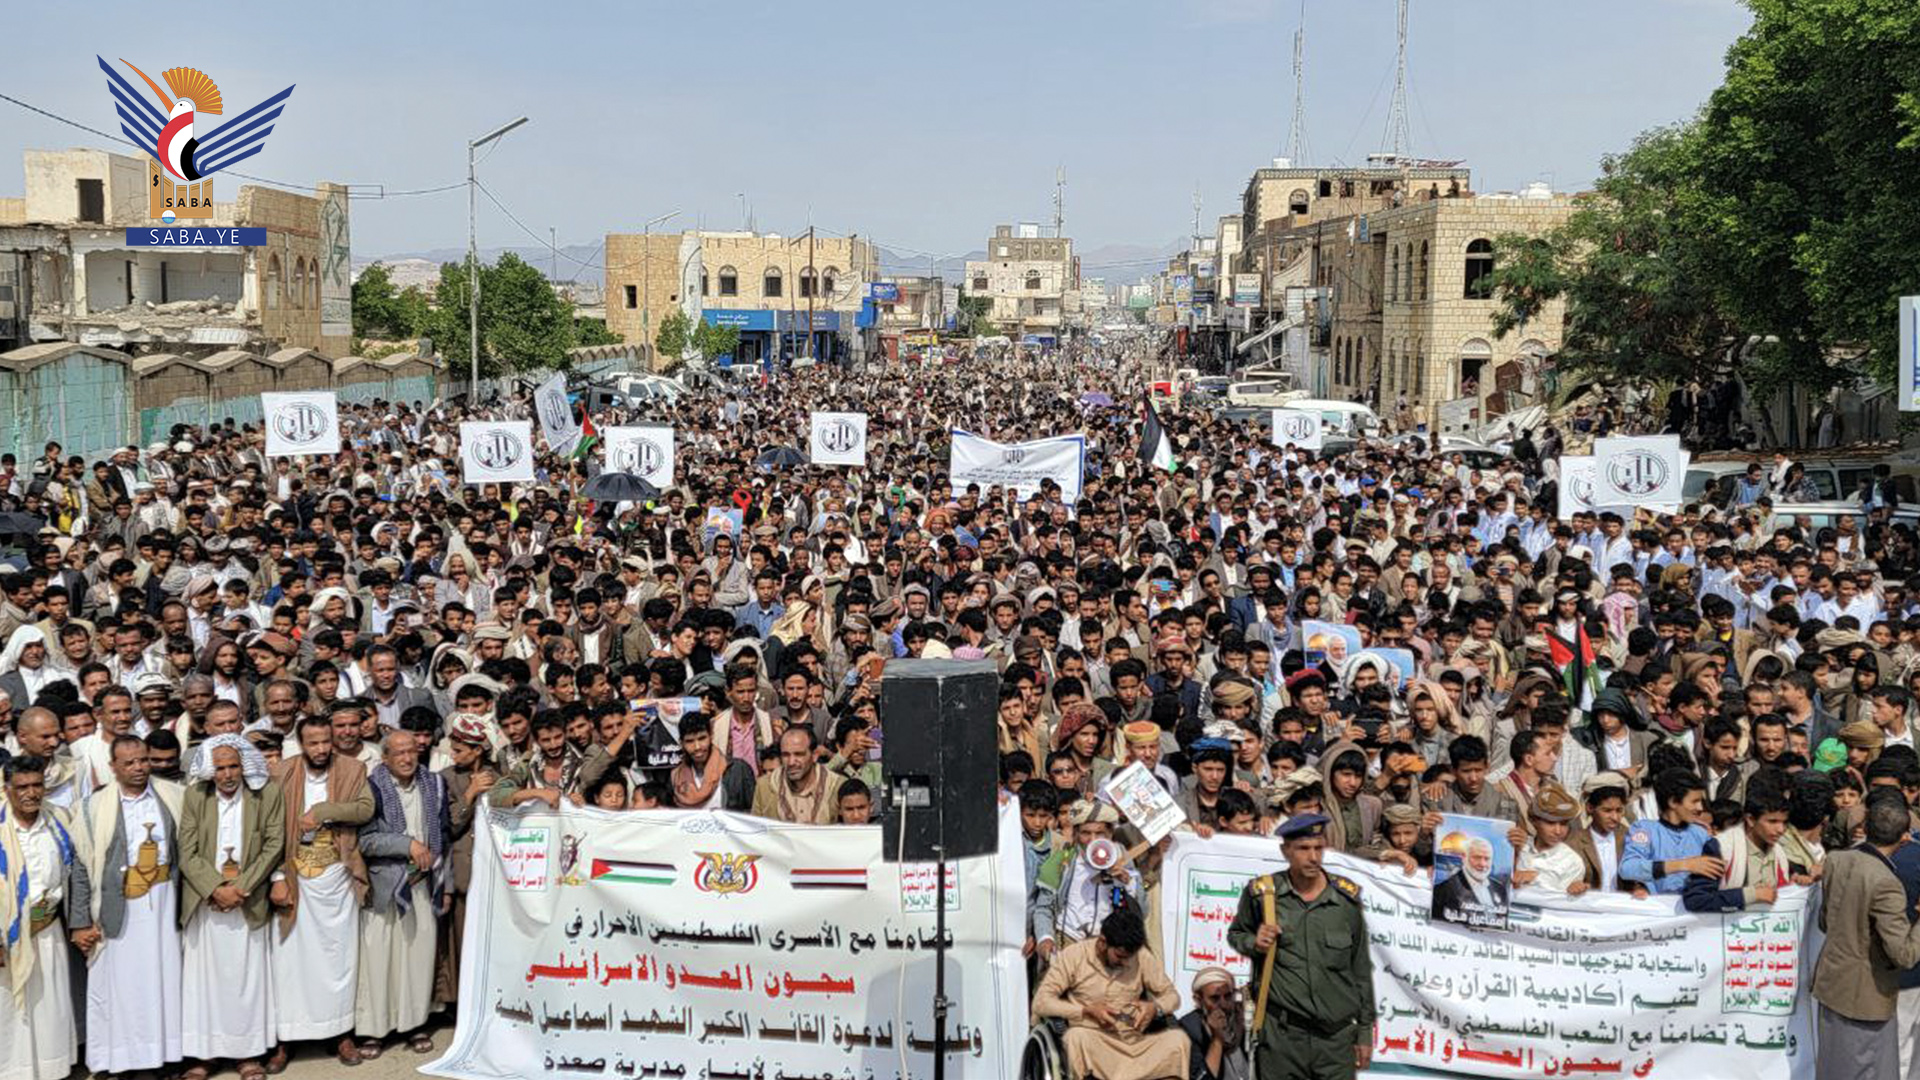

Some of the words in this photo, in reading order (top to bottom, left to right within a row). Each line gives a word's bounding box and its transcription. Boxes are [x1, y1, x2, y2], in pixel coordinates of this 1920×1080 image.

[565, 908, 583, 944] في
[589, 909, 643, 938] الأحرار
[649, 920, 761, 949] الفلسطينيين
[1644, 926, 1687, 946] تلبية
[1726, 913, 1770, 939] أكبر
[1772, 916, 1797, 933] الله
[849, 933, 876, 954] مع
[1400, 934, 1428, 952] الملك
[1431, 942, 1458, 959] عبد
[1474, 942, 1515, 962] القائد
[1519, 948, 1559, 969] السيد
[1639, 954, 1707, 980] واستجابة
[666, 962, 753, 992] العدو
[764, 970, 855, 998] سجون
[1459, 966, 1518, 1001] القرآن
[1523, 975, 1624, 1012] أكاديمية
[1632, 985, 1699, 1016] تقيم
[496, 988, 534, 1028] هنية
[621, 1005, 693, 1040] الشهيد
[698, 1010, 750, 1046] الكبير
[758, 1011, 826, 1045] القائد
[833, 1018, 893, 1053] لدعوة
[1455, 1013, 1555, 1039] الفلسطيني
[1560, 1021, 1624, 1048] الشعب
[1442, 1038, 1534, 1069] العدو
[1628, 1029, 1653, 1051] مع
[1735, 1025, 1798, 1057] وقفة
[544, 1051, 606, 1071] صعدة
[1544, 1055, 1622, 1077] سجون
